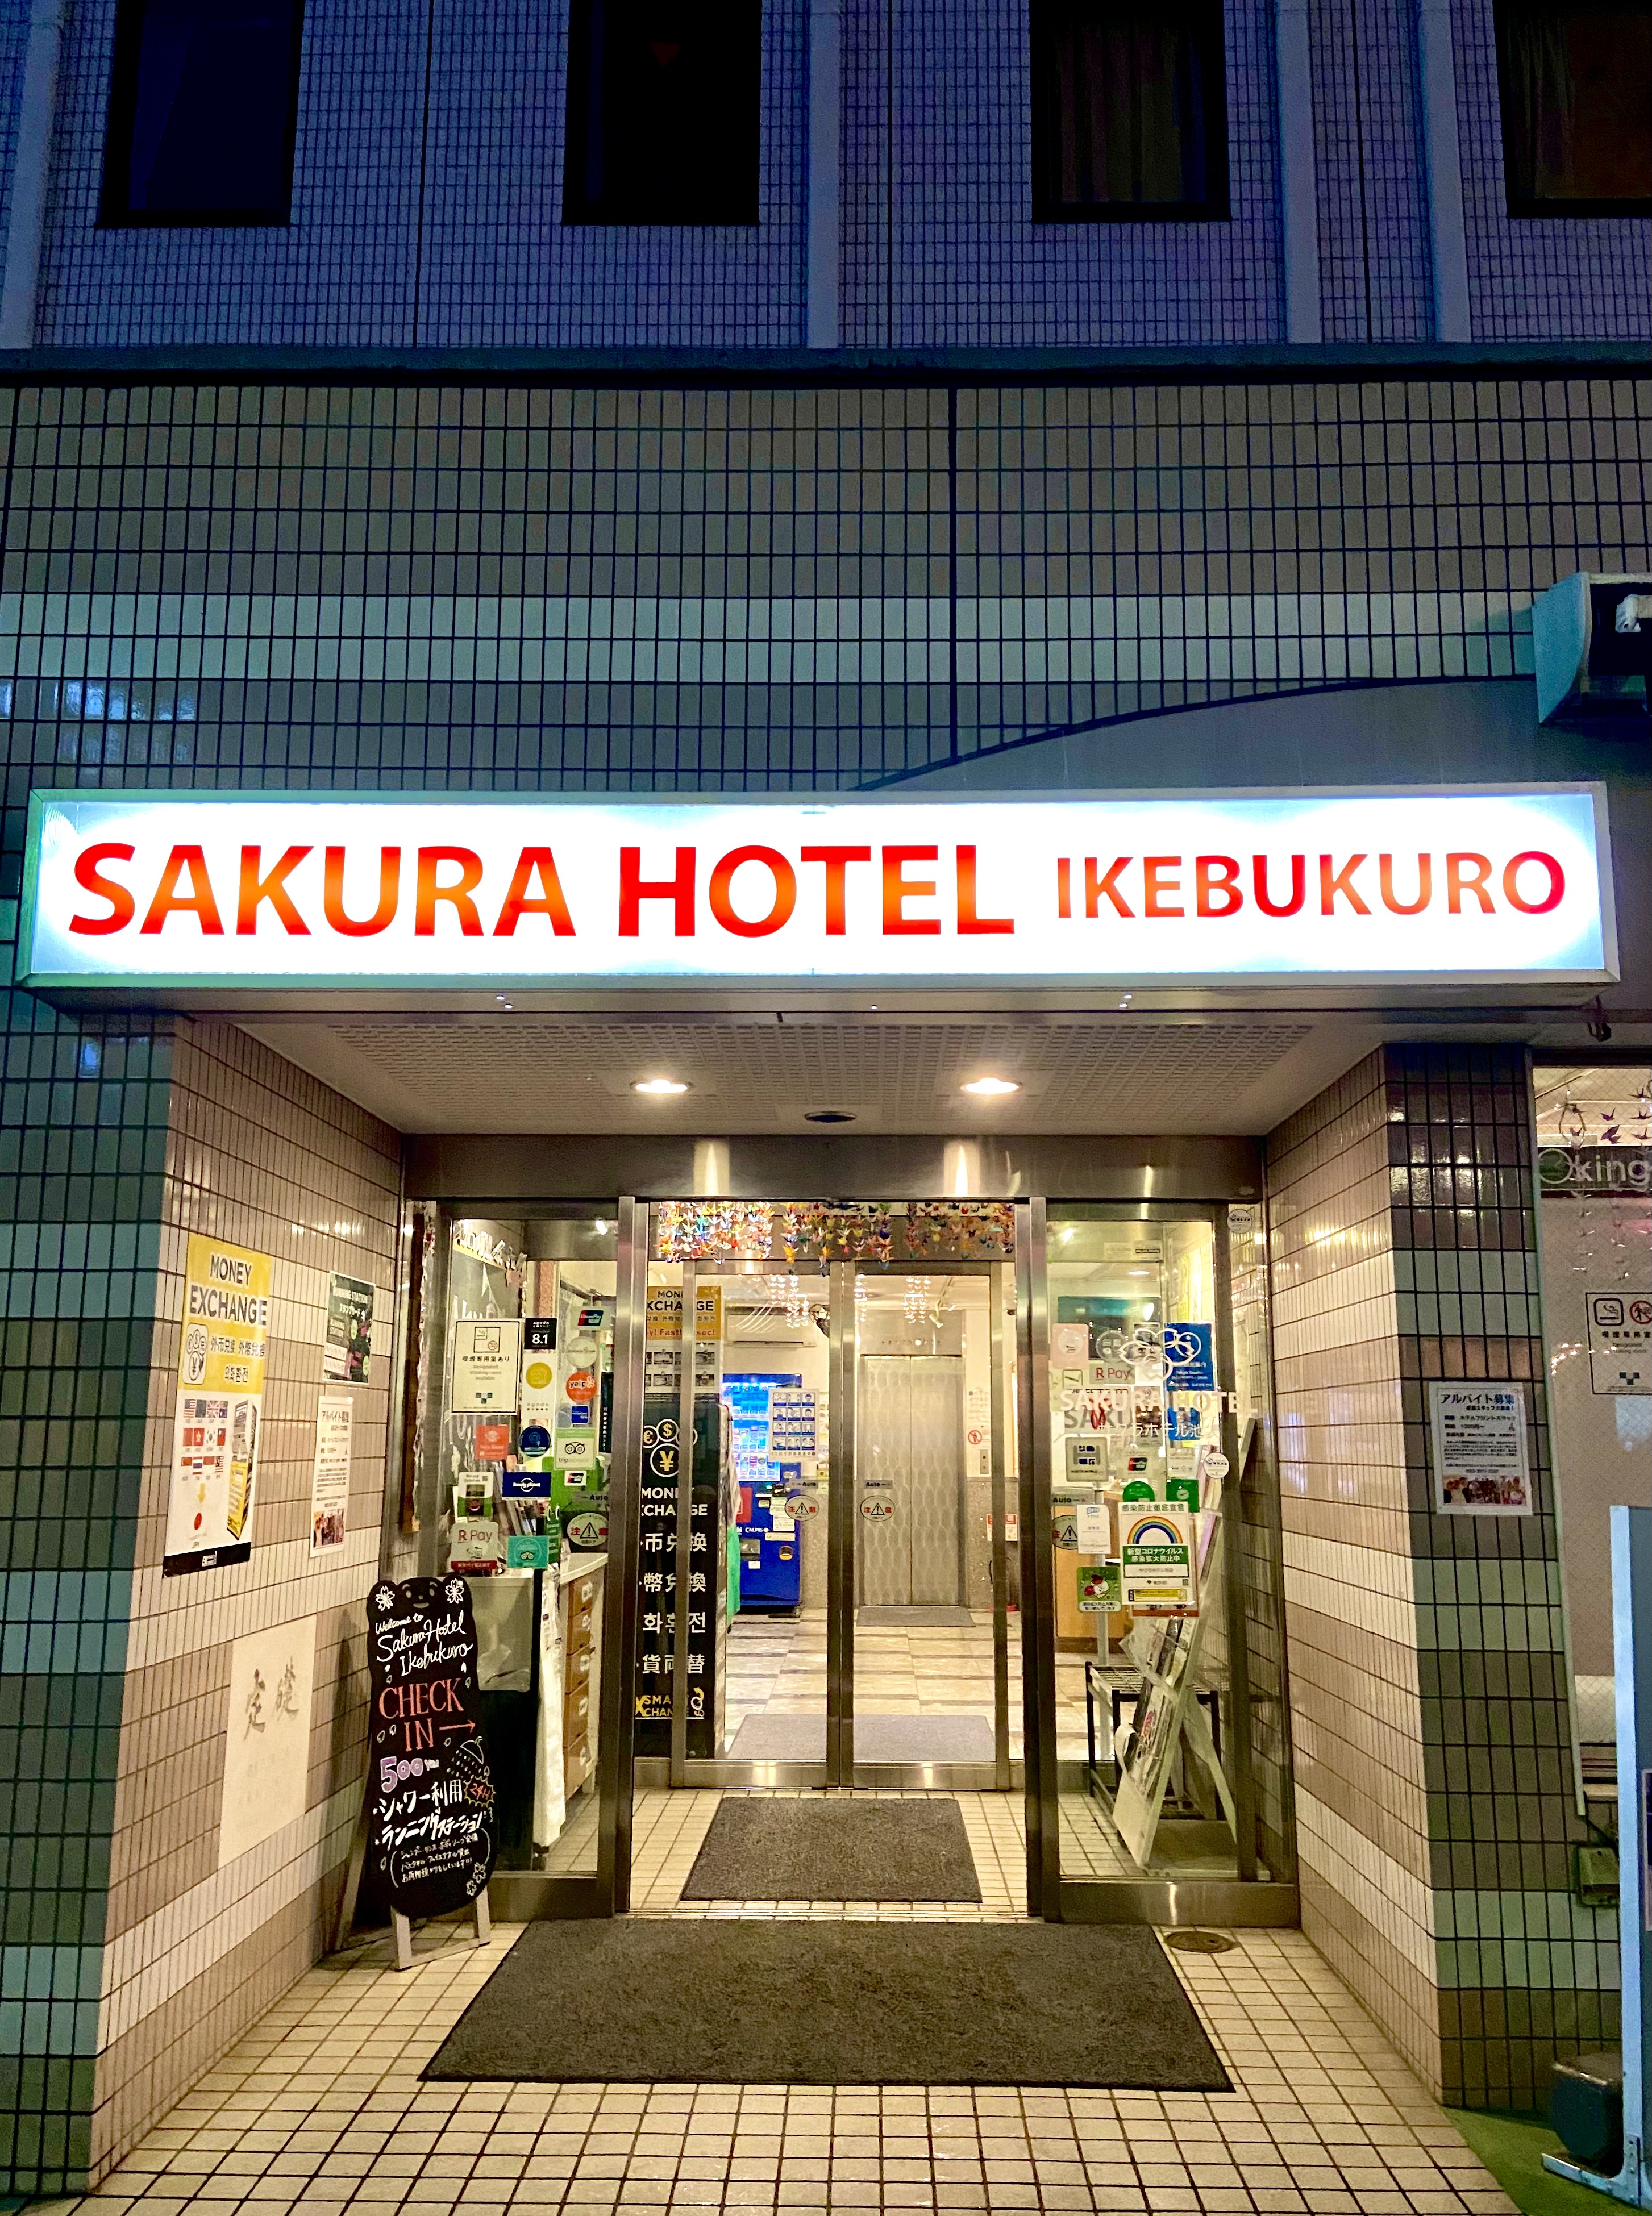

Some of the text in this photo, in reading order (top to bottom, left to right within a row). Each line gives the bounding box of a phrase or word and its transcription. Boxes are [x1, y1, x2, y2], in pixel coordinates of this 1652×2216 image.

[69, 842, 1565, 937] SAKURA HOTEL IKEBUKURO
[210, 1255, 252, 1286] MONEY
[190, 1285, 267, 1325] EXCHANGE
[647, 1301, 714, 1311] XCHAGE
[532, 1334, 548, 1344] 8.1
[1108, 1368, 1130, 1380] Pay
[1060, 1390, 1258, 1413] SAKURA HOTE
[1441, 1394, 1515, 1404] アルバイト募集
[642, 1488, 694, 1499] MON
[642, 1504, 708, 1516] CHAGE
[471, 1530, 492, 1542] Pay
[640, 1532, 707, 1552] 币兑换
[375, 1613, 424, 1635] Welcome to
[377, 1610, 466, 1662] Sakura Hotel
[400, 1642, 473, 1676] Ikebukuro
[379, 1678, 464, 1719] CHECK
[404, 1718, 434, 1752] IN
[380, 1756, 423, 1793] 500
